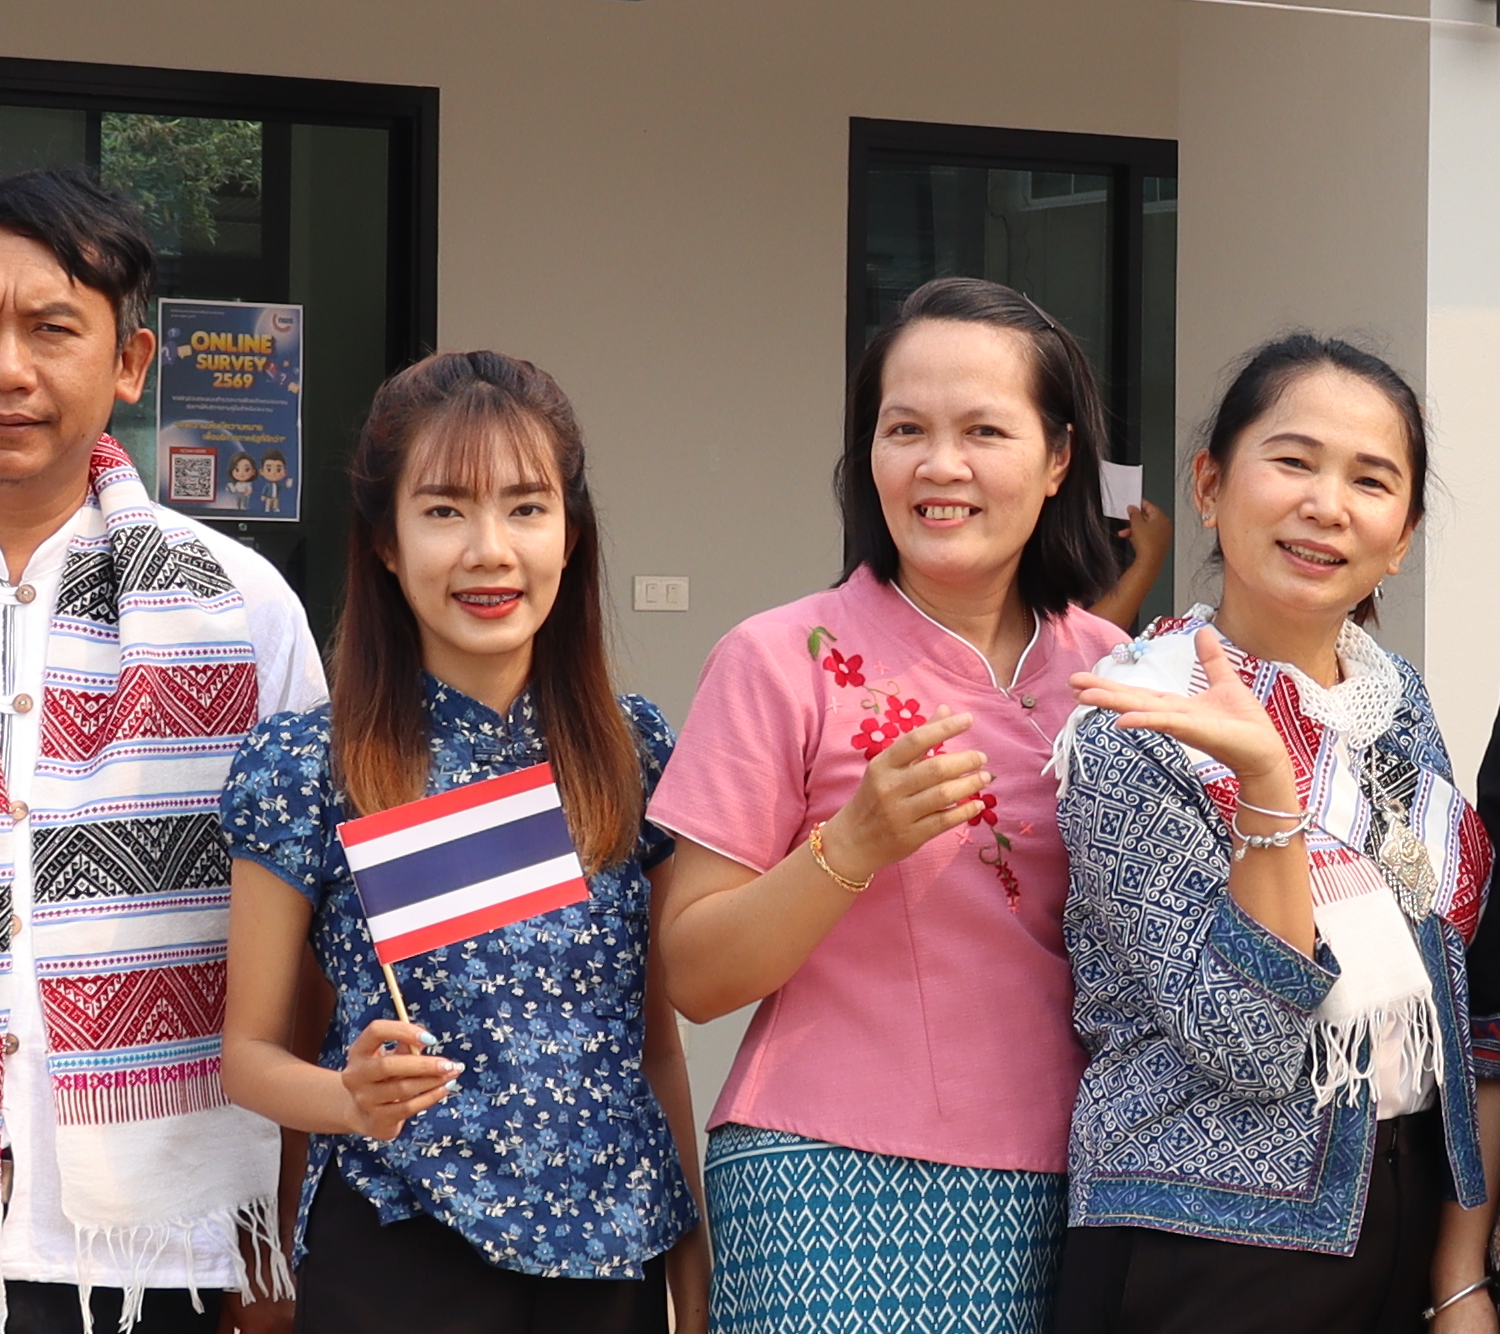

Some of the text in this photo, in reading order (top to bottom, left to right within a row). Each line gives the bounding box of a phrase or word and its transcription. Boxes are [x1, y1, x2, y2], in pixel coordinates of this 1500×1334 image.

[191, 330, 273, 354] ONLINE
[196, 354, 267, 371] SURVEY
[213, 372, 254, 389] 2569
